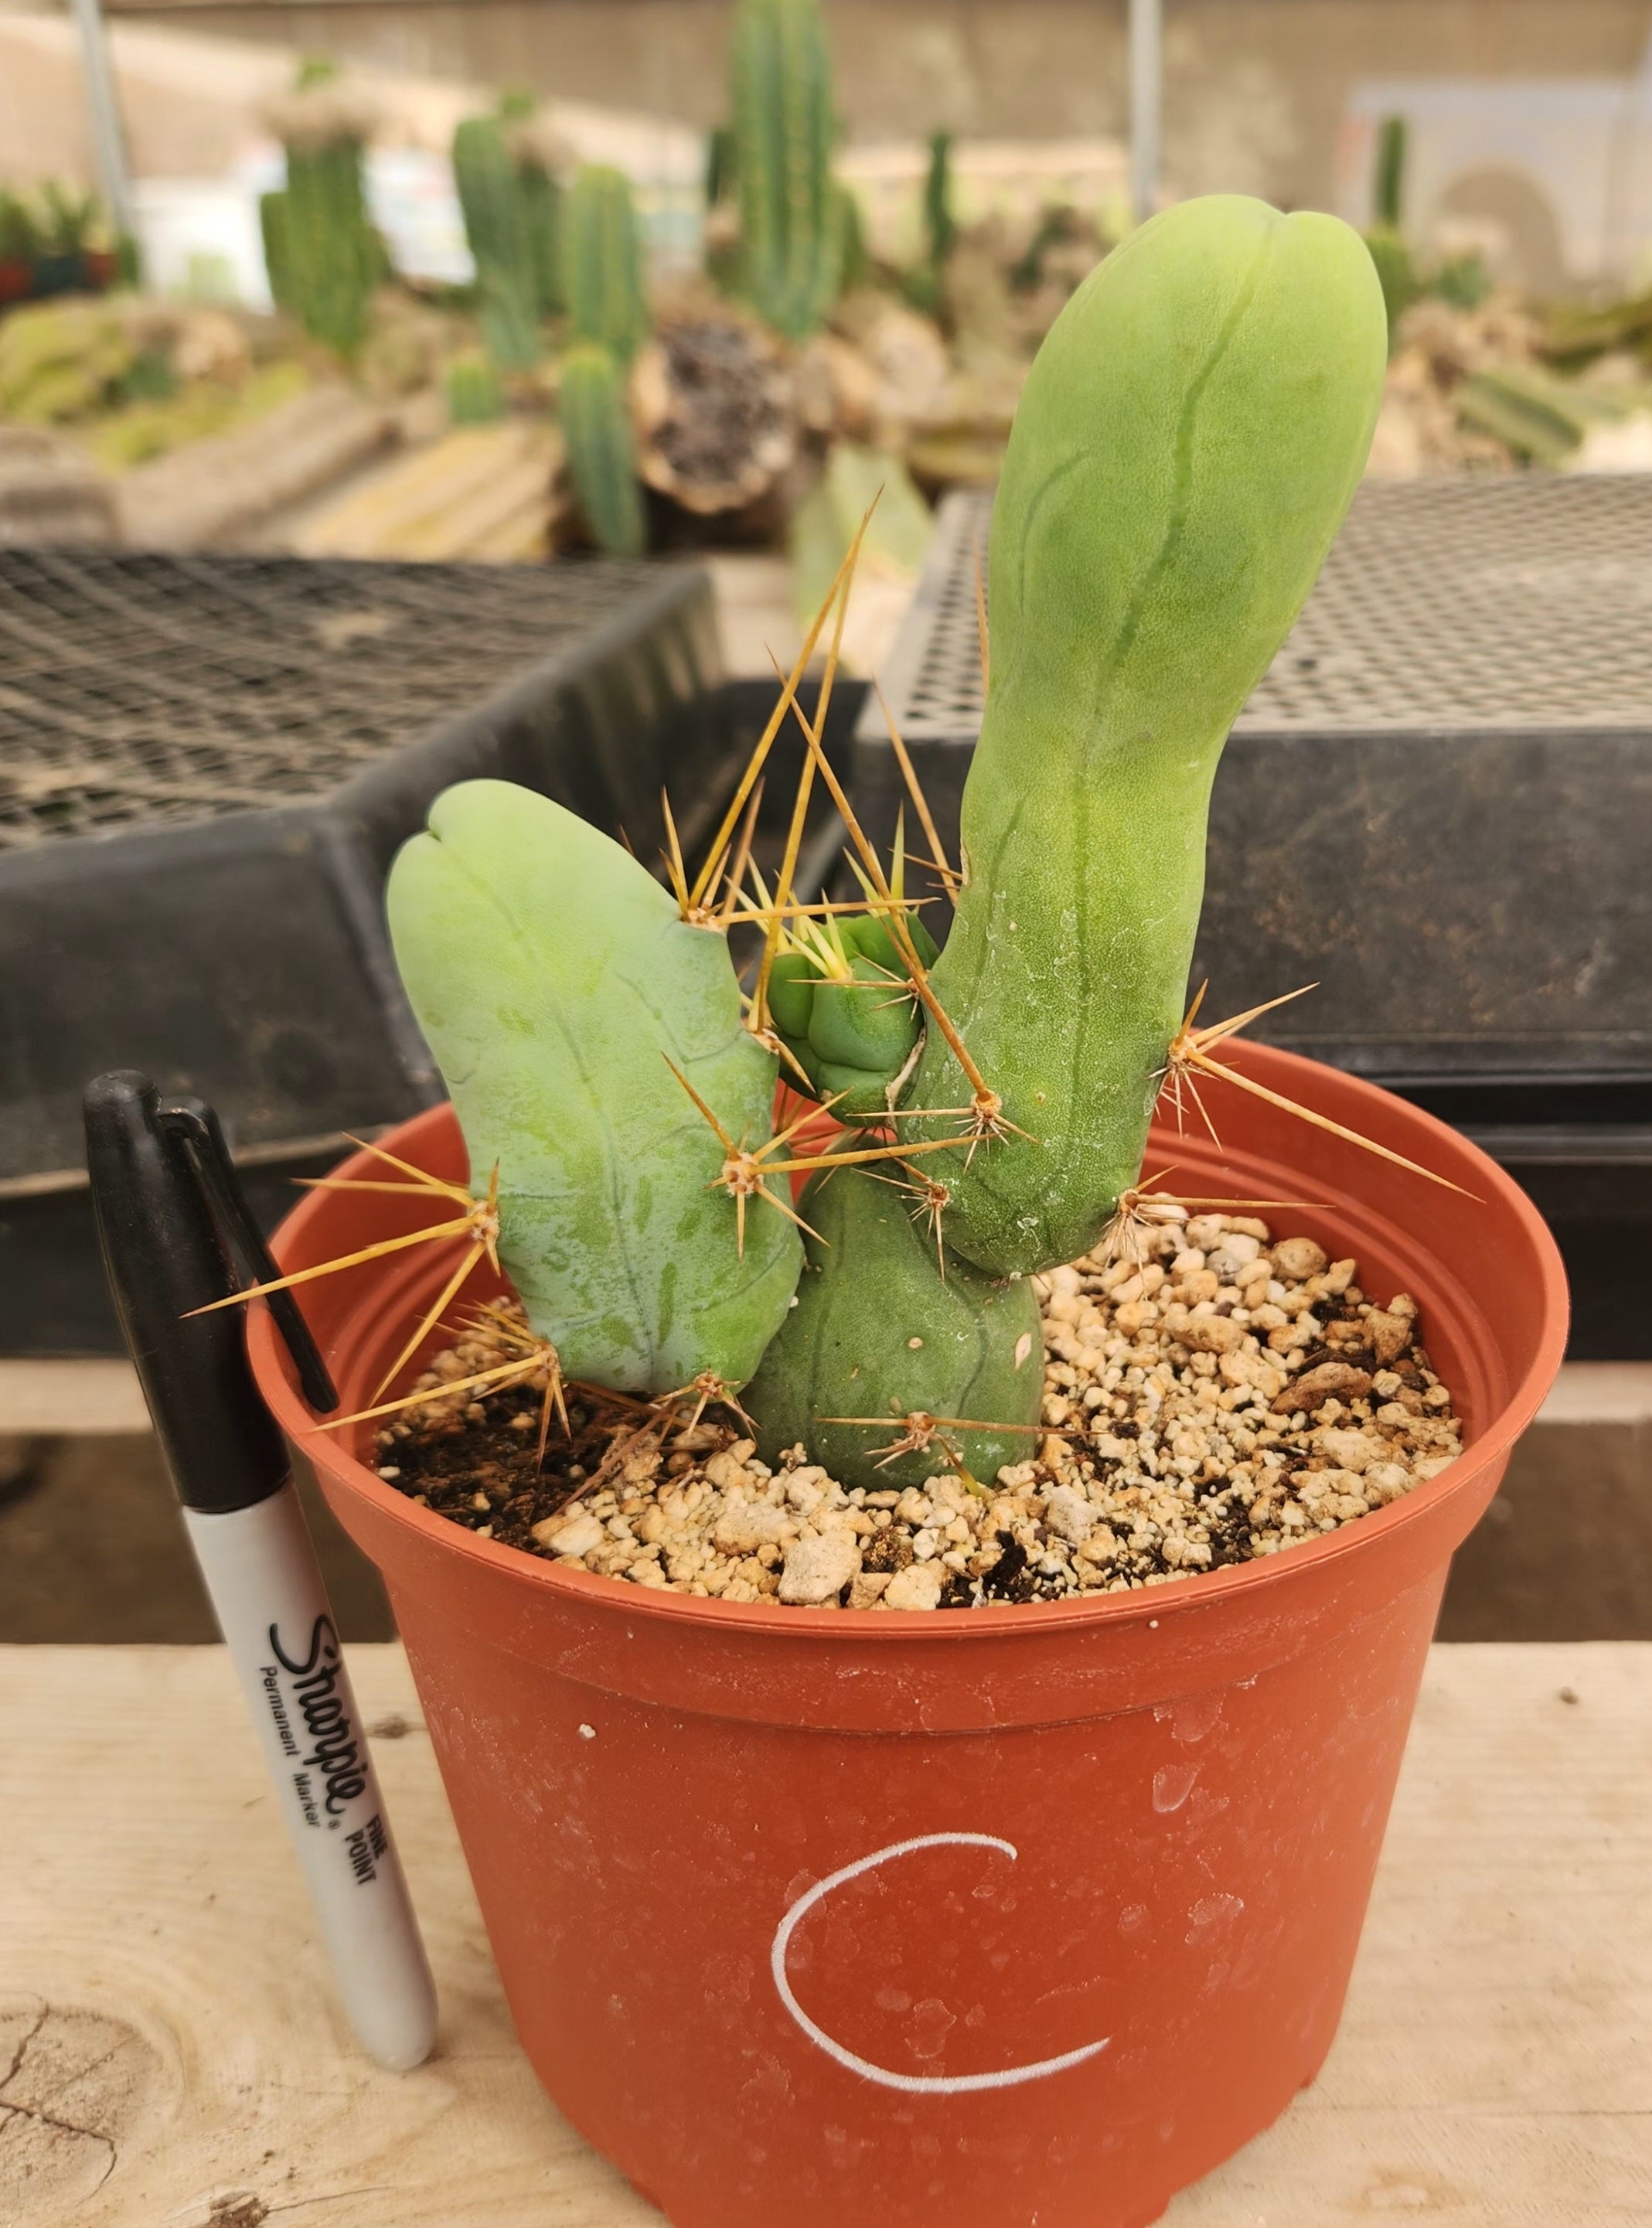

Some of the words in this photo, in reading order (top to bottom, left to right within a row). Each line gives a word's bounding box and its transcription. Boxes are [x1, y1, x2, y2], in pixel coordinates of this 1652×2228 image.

[260, 1666, 301, 1757] Permanent
[292, 1772, 321, 1829] Marker
[270, 1613, 369, 1815] Sharpie
[345, 1830, 377, 1886] POINT
[366, 1814, 389, 1860] FINE
[770, 1831, 1111, 2096] C
